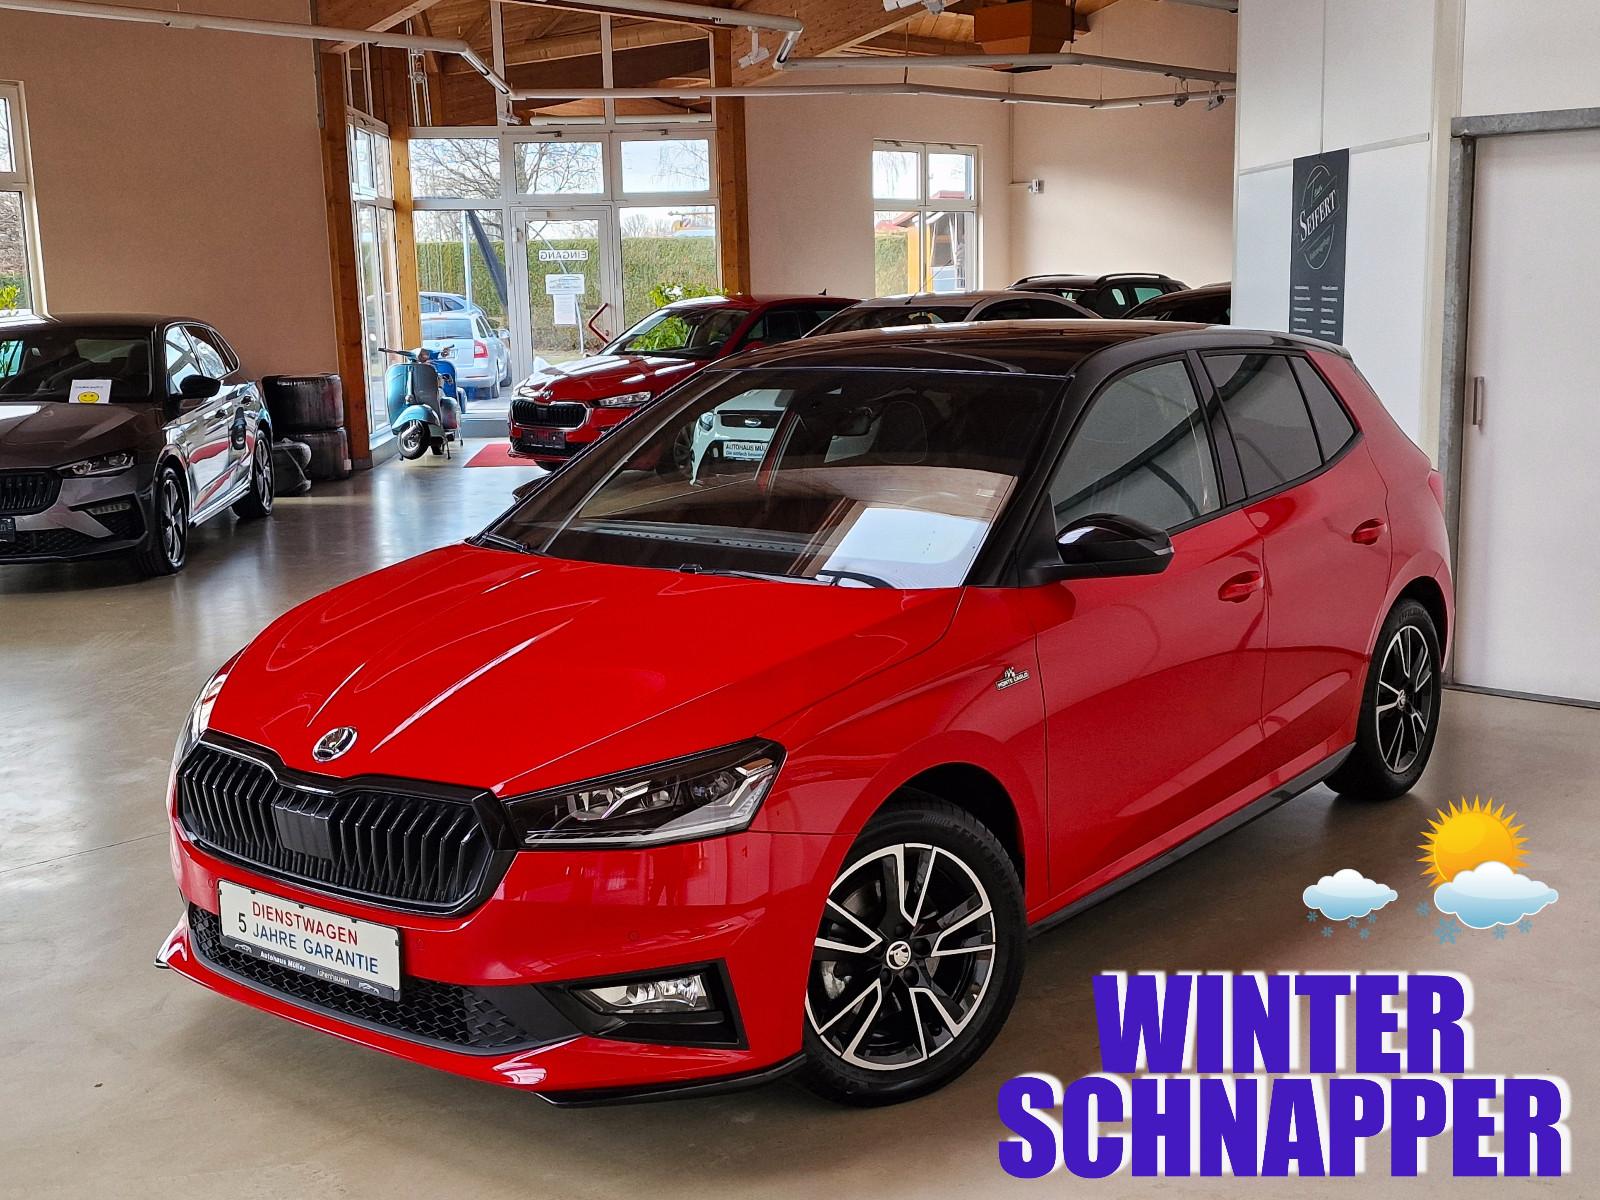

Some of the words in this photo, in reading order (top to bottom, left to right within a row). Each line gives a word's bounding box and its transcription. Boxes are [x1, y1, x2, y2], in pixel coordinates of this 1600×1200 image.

[1299, 189, 1336, 241] SEIFERT
[725, 443, 754, 451] AUTOHAUS
[238, 911, 247, 933] 5
[252, 922, 297, 950] JAHRE
[303, 938, 379, 975] GARANTIE
[252, 901, 358, 946] DIENSTWAGEN
[260, 950, 287, 966] Autohaus
[287, 960, 306, 972] Müller
